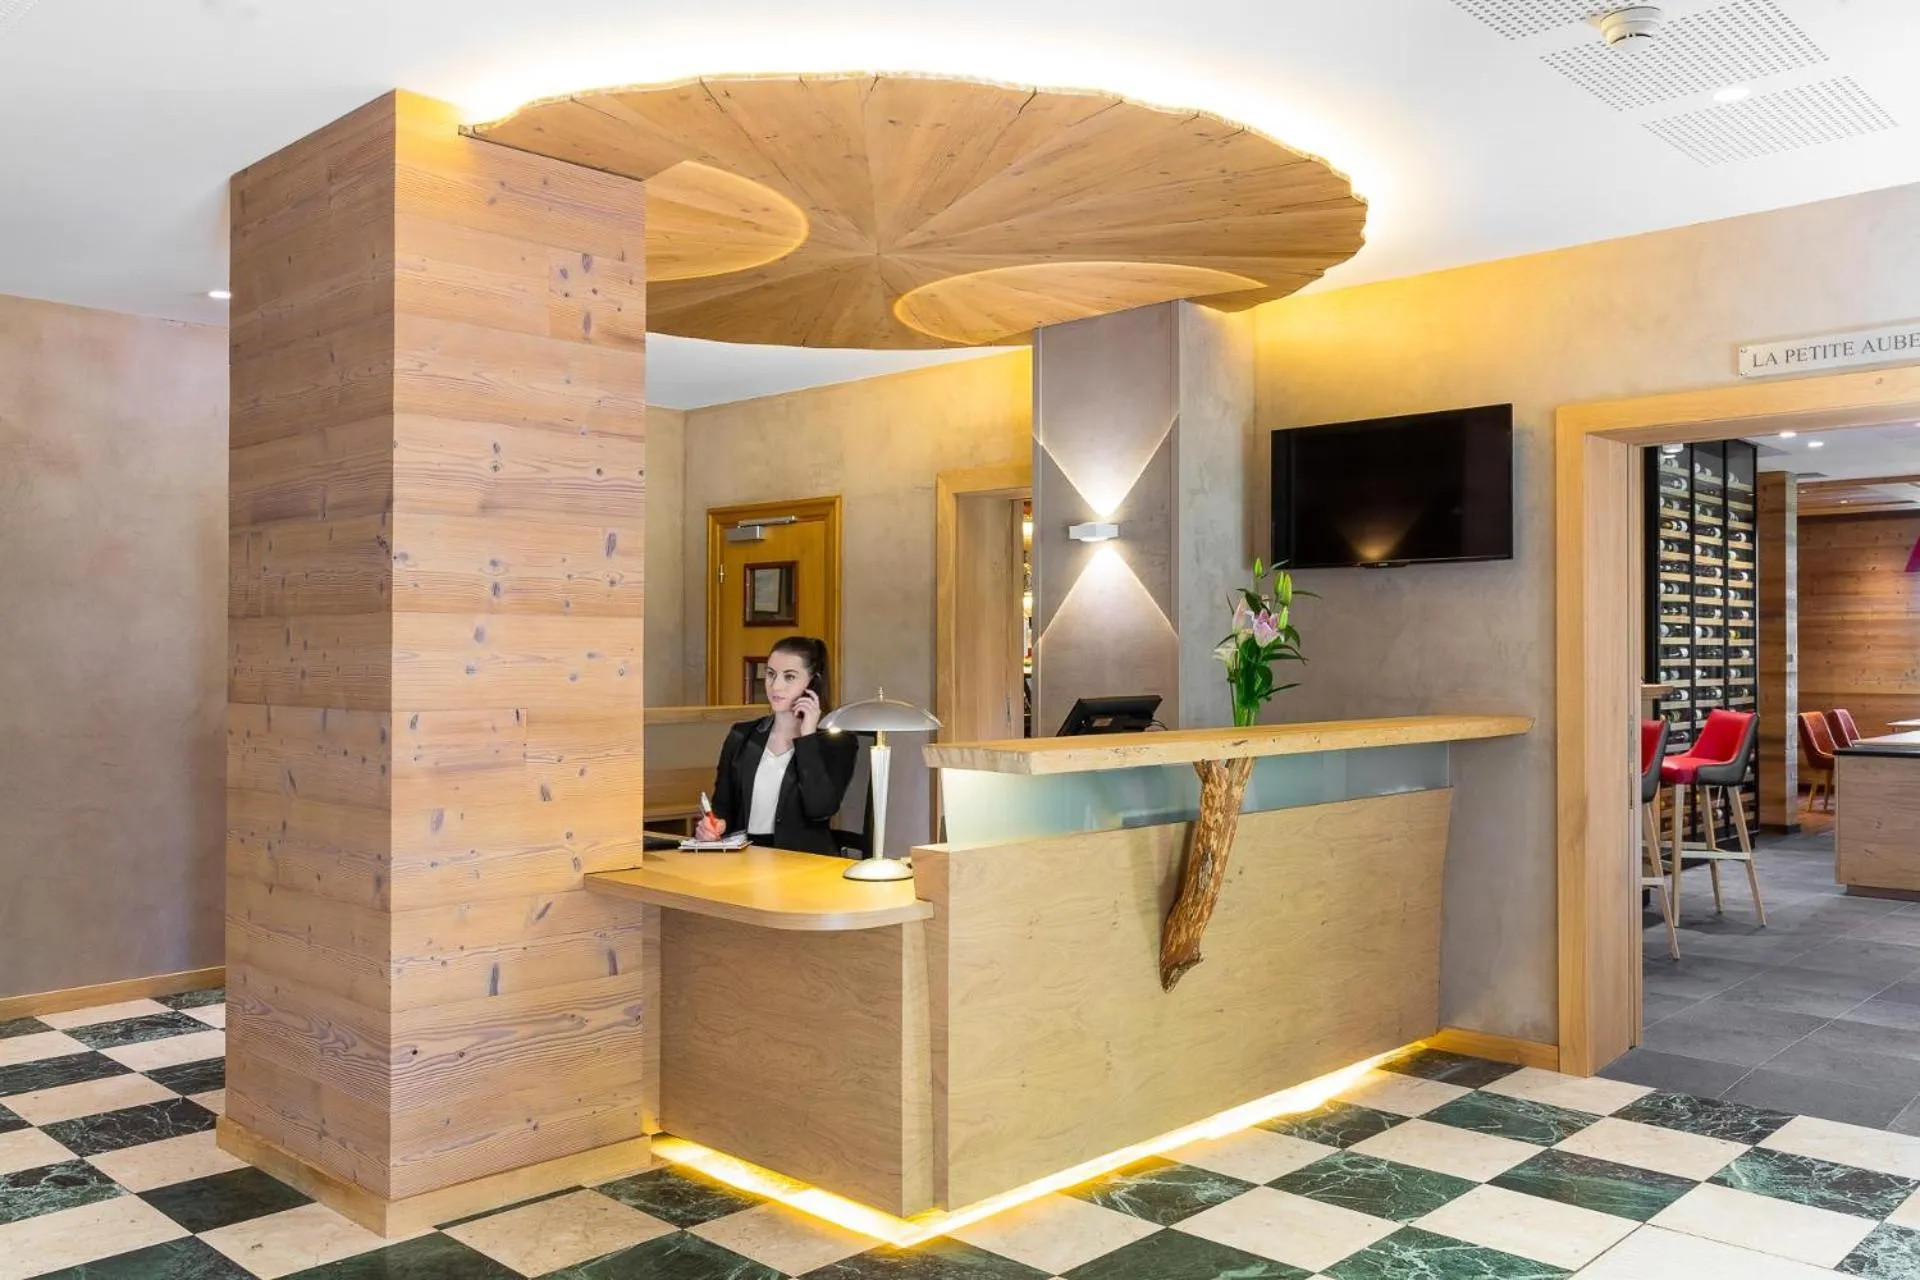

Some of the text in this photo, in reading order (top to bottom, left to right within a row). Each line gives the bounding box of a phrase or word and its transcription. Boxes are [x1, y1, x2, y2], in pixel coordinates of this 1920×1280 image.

[1753, 332, 1920, 368] LA PETITE AUBE
